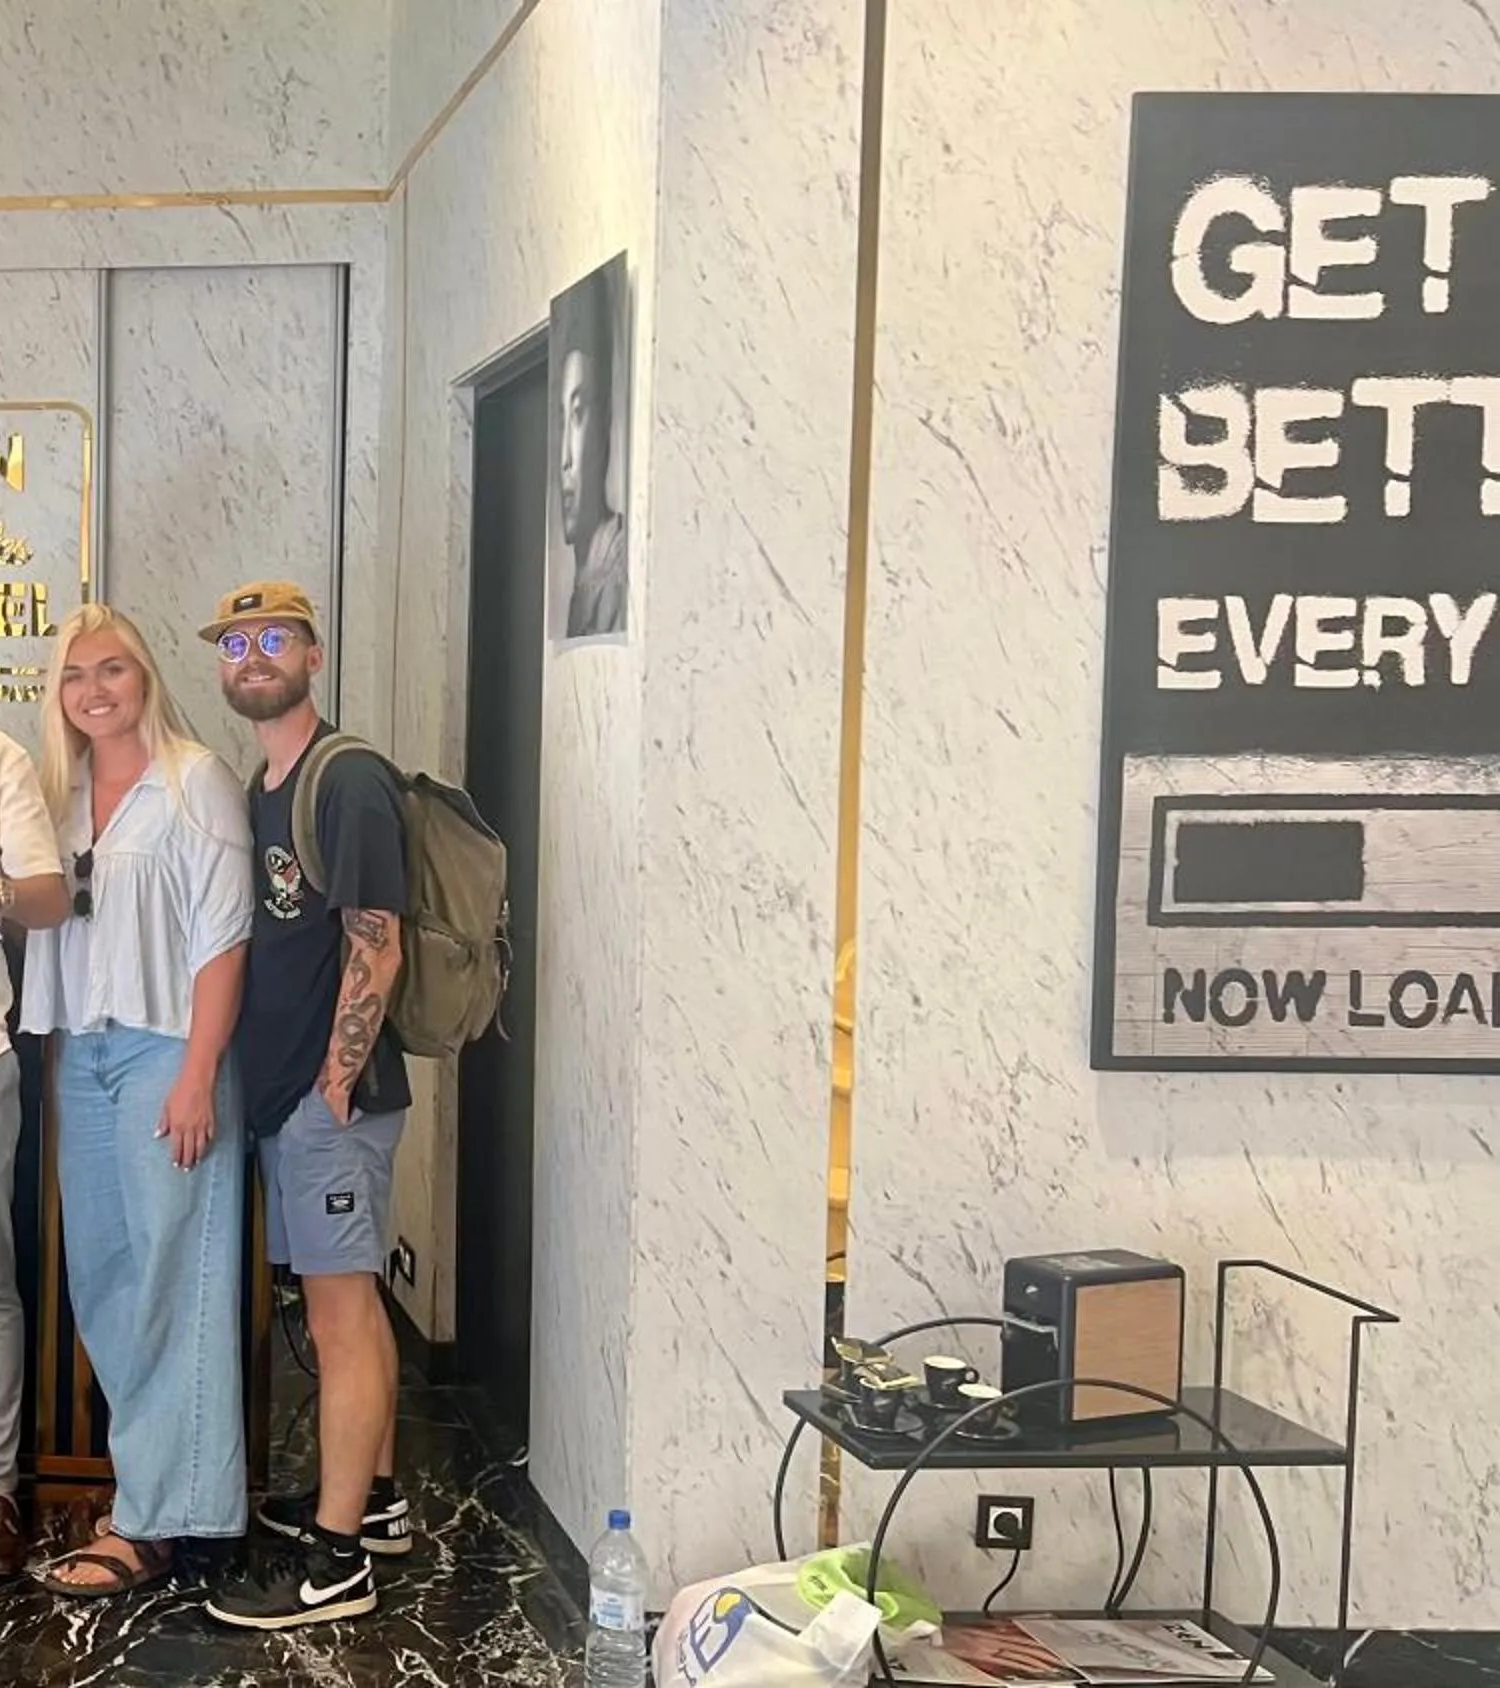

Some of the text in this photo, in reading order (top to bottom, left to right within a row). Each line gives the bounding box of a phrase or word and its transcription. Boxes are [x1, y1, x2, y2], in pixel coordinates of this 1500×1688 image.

[1171, 173, 1492, 324] GET
[1157, 592, 1497, 690] EVERY
[1163, 967, 1327, 1027] NOW
